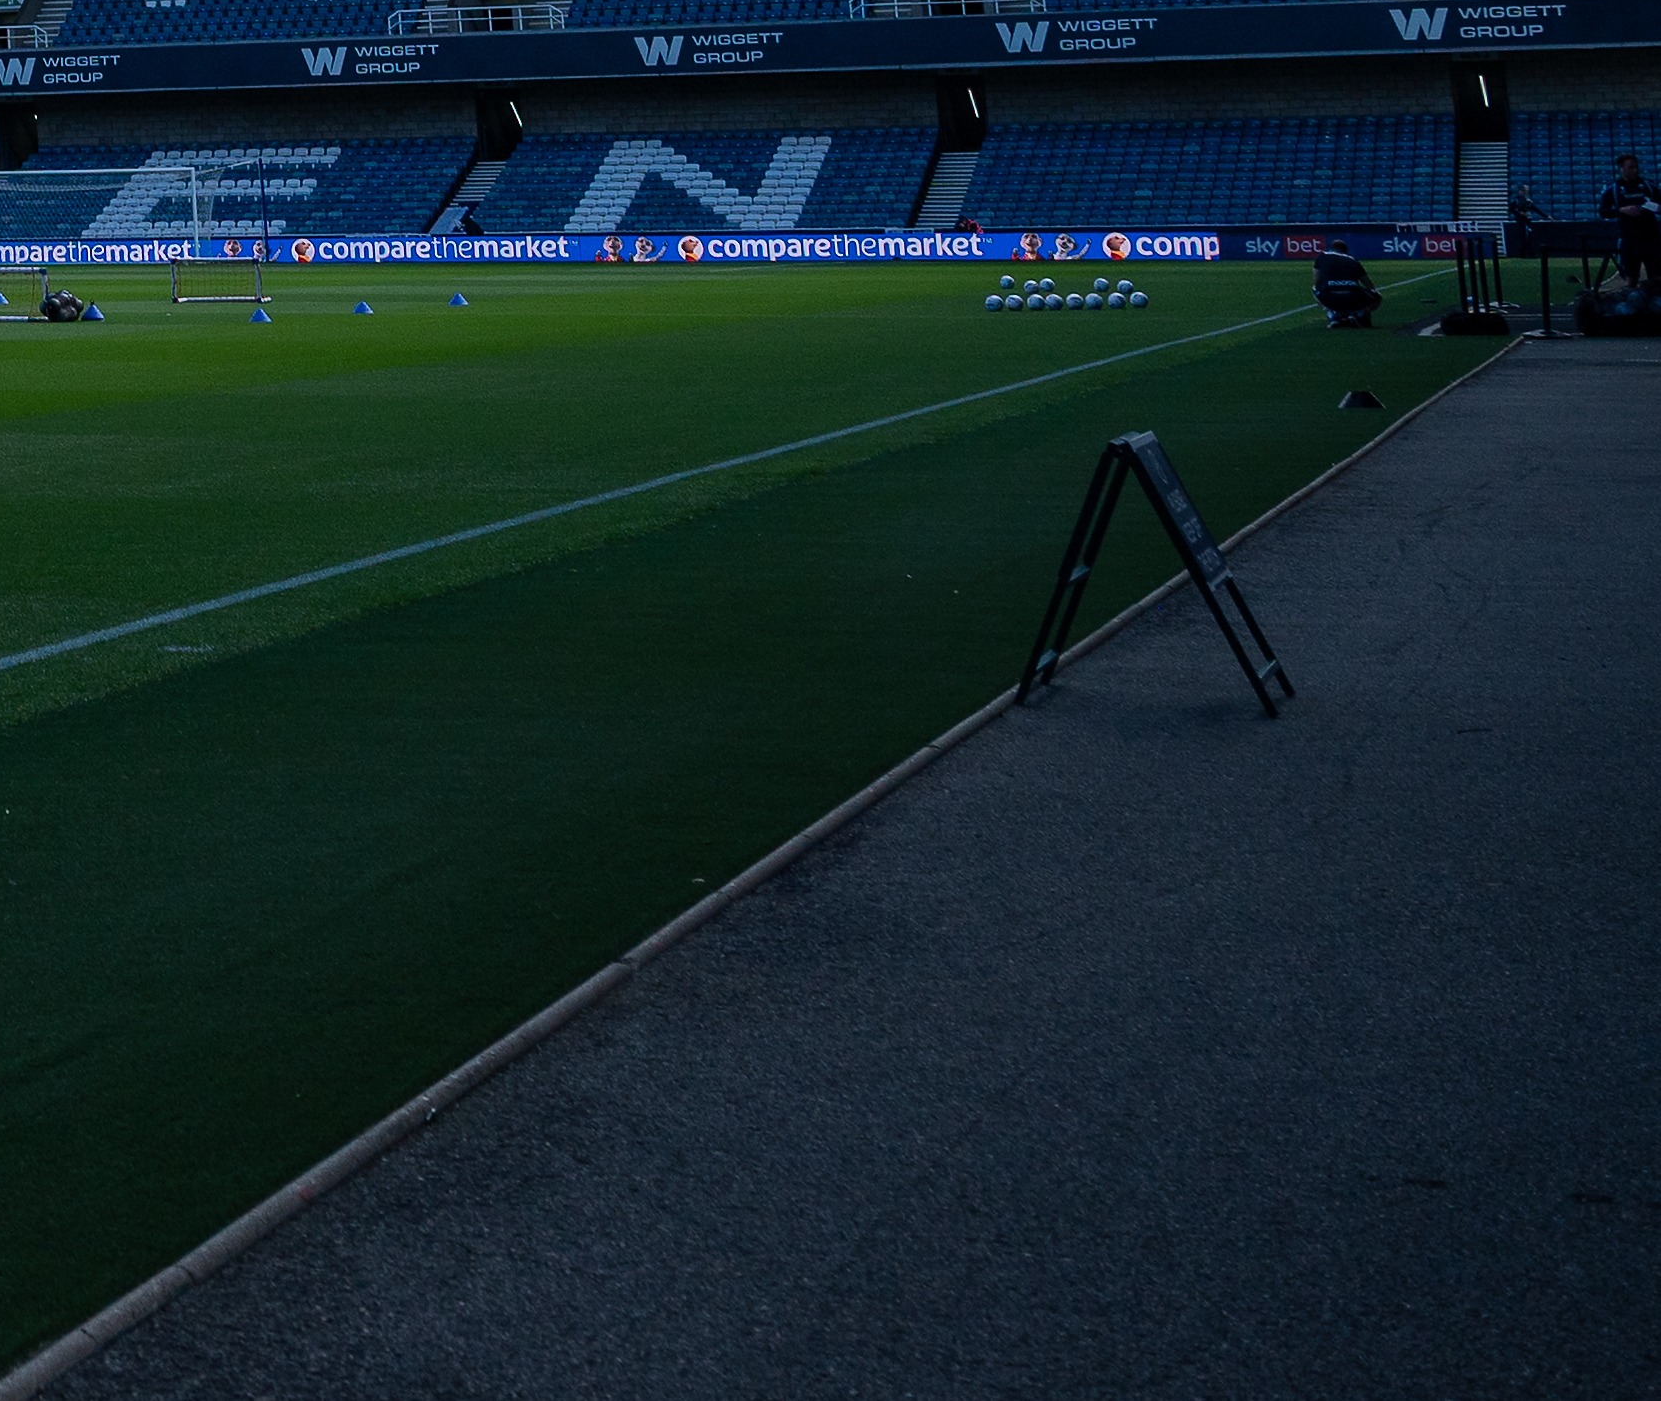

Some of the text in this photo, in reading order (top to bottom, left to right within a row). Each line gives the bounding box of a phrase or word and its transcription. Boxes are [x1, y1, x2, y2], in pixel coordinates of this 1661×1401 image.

[1458, 4, 1567, 19] WIGGETT
[1057, 18, 1158, 32] WIGGETT
[1459, 24, 1544, 38] GROUP
[691, 32, 783, 46] WIGGETT
[1059, 37, 1136, 50] GROUP
[354, 44, 439, 57] WIGGETT
[693, 50, 763, 64] GROUP
[42, 55, 120, 68] WIGGETT
[355, 61, 421, 74] GROUP
[42, 72, 104, 84] GROUP
[318, 235, 570, 263] comparethemarket
[707, 232, 982, 262] comparethemarket
[1136, 236, 1220, 262] comp
[1245, 236, 1323, 257] sky bet
[1382, 236, 1418, 257] sky
